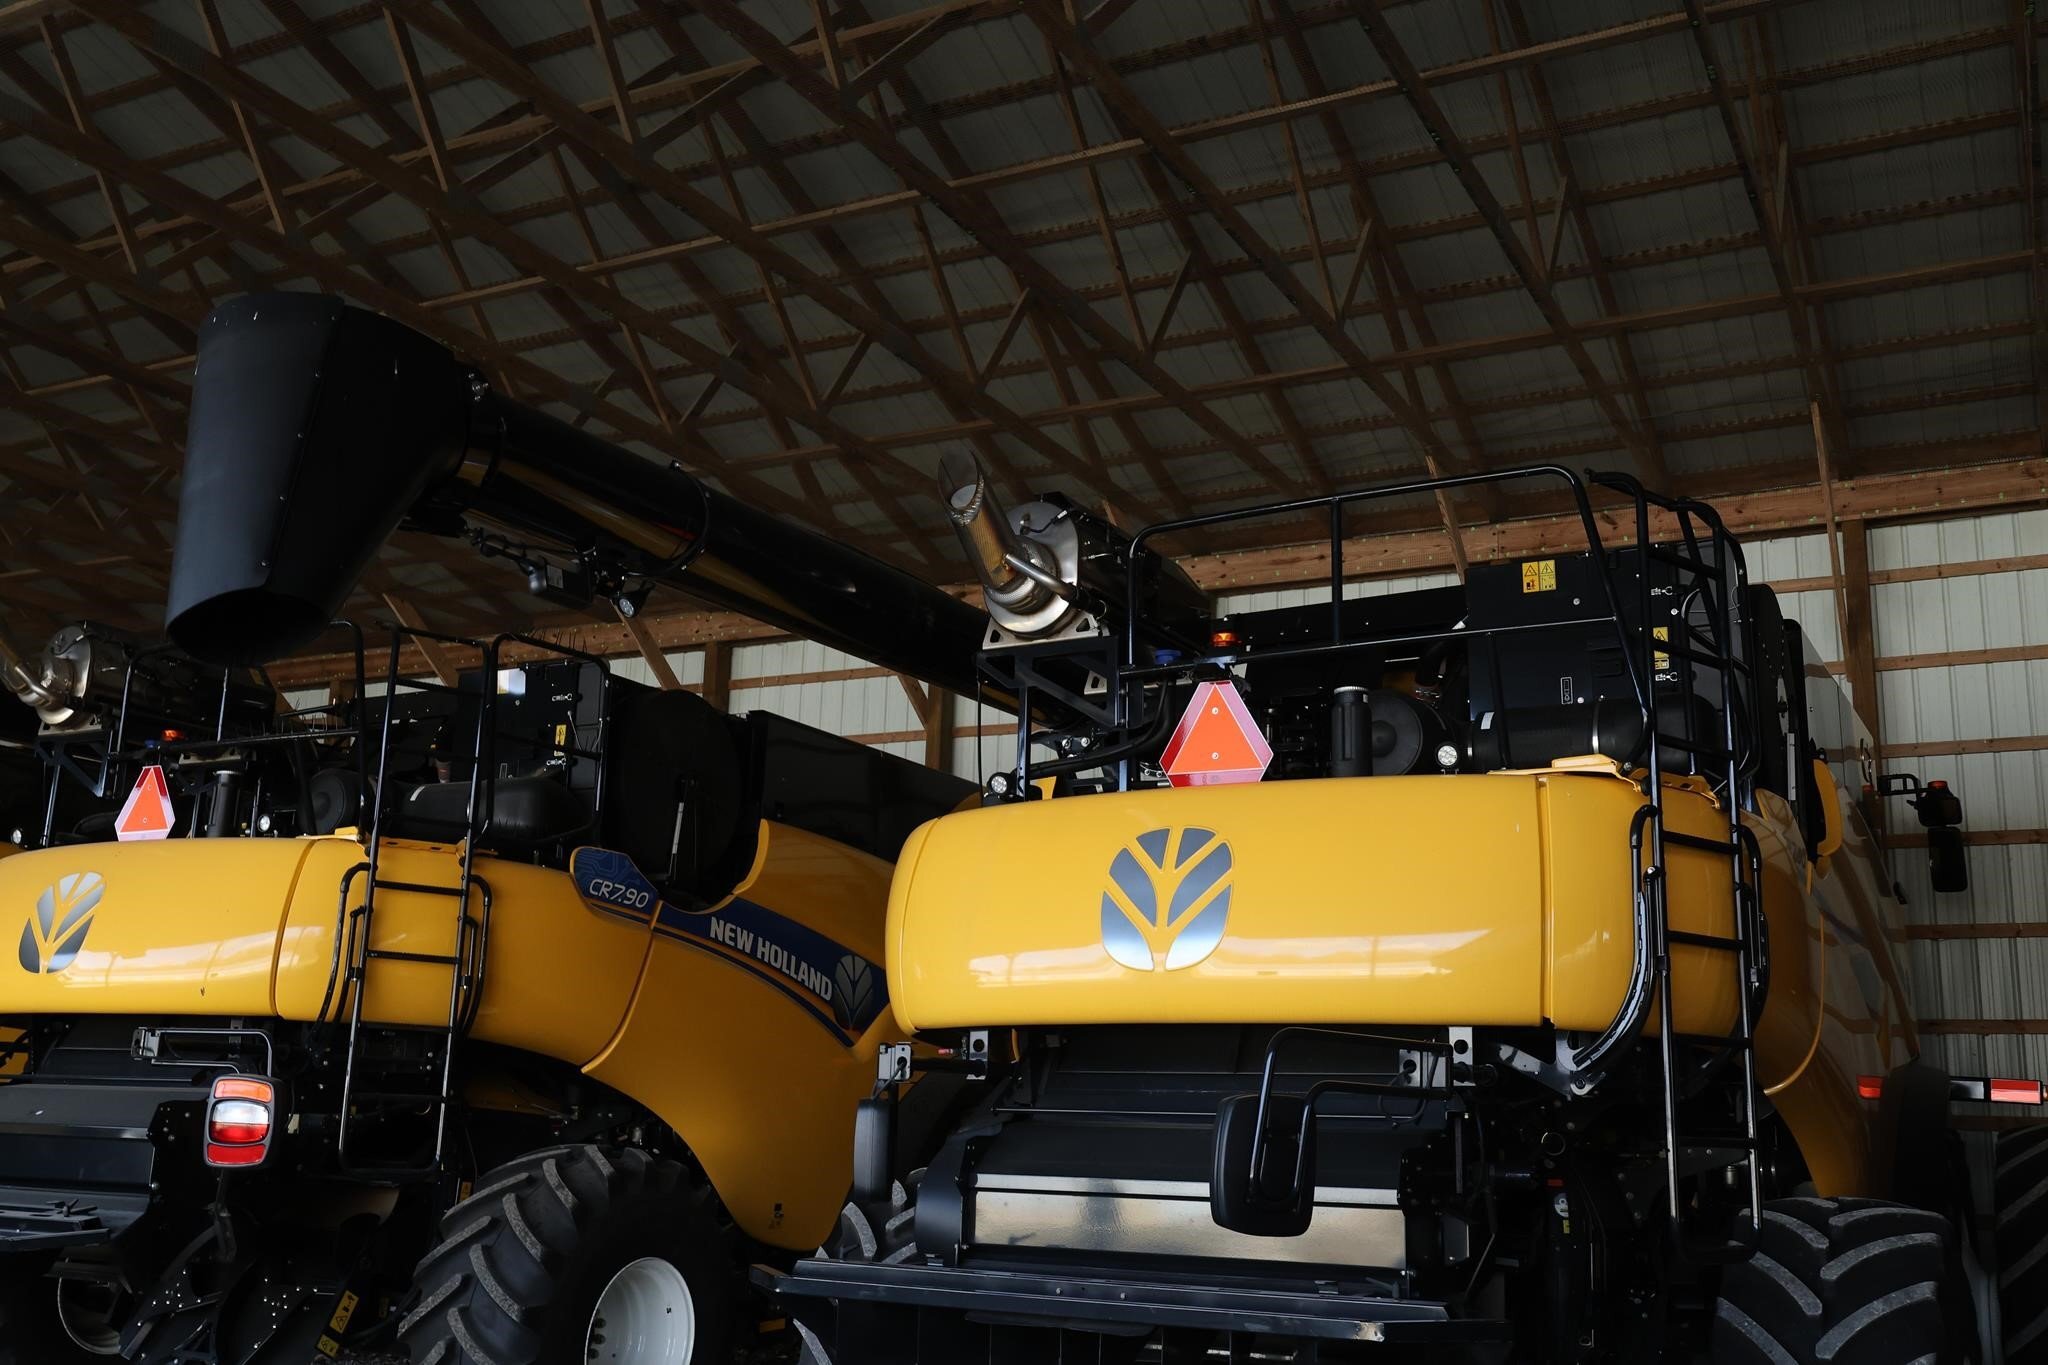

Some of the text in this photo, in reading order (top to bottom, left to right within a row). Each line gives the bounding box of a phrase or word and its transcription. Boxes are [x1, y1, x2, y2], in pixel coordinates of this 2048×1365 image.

[589, 879, 649, 908] CR7.90
[709, 916, 833, 1001] NEW HOLLAND
